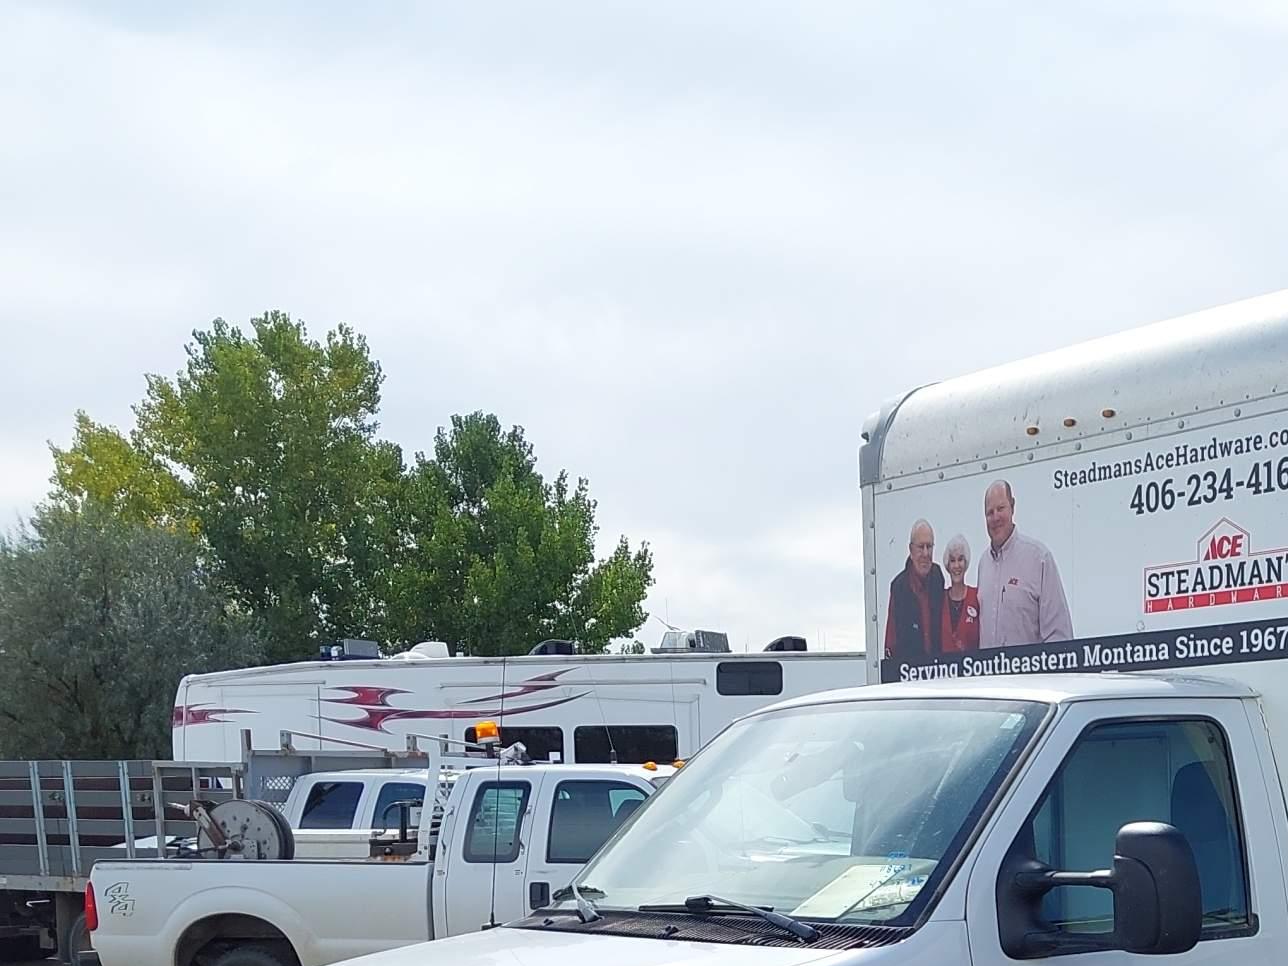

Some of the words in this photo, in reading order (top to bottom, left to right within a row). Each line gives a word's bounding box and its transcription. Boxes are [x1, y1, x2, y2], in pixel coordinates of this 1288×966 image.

[1204, 534, 1243, 561] ACE
[963, 651, 1078, 677] Southeastern
[1082, 642, 1169, 667] Montana
[1176, 634, 1233, 659] Since
[1240, 626, 1288, 653] 1967
